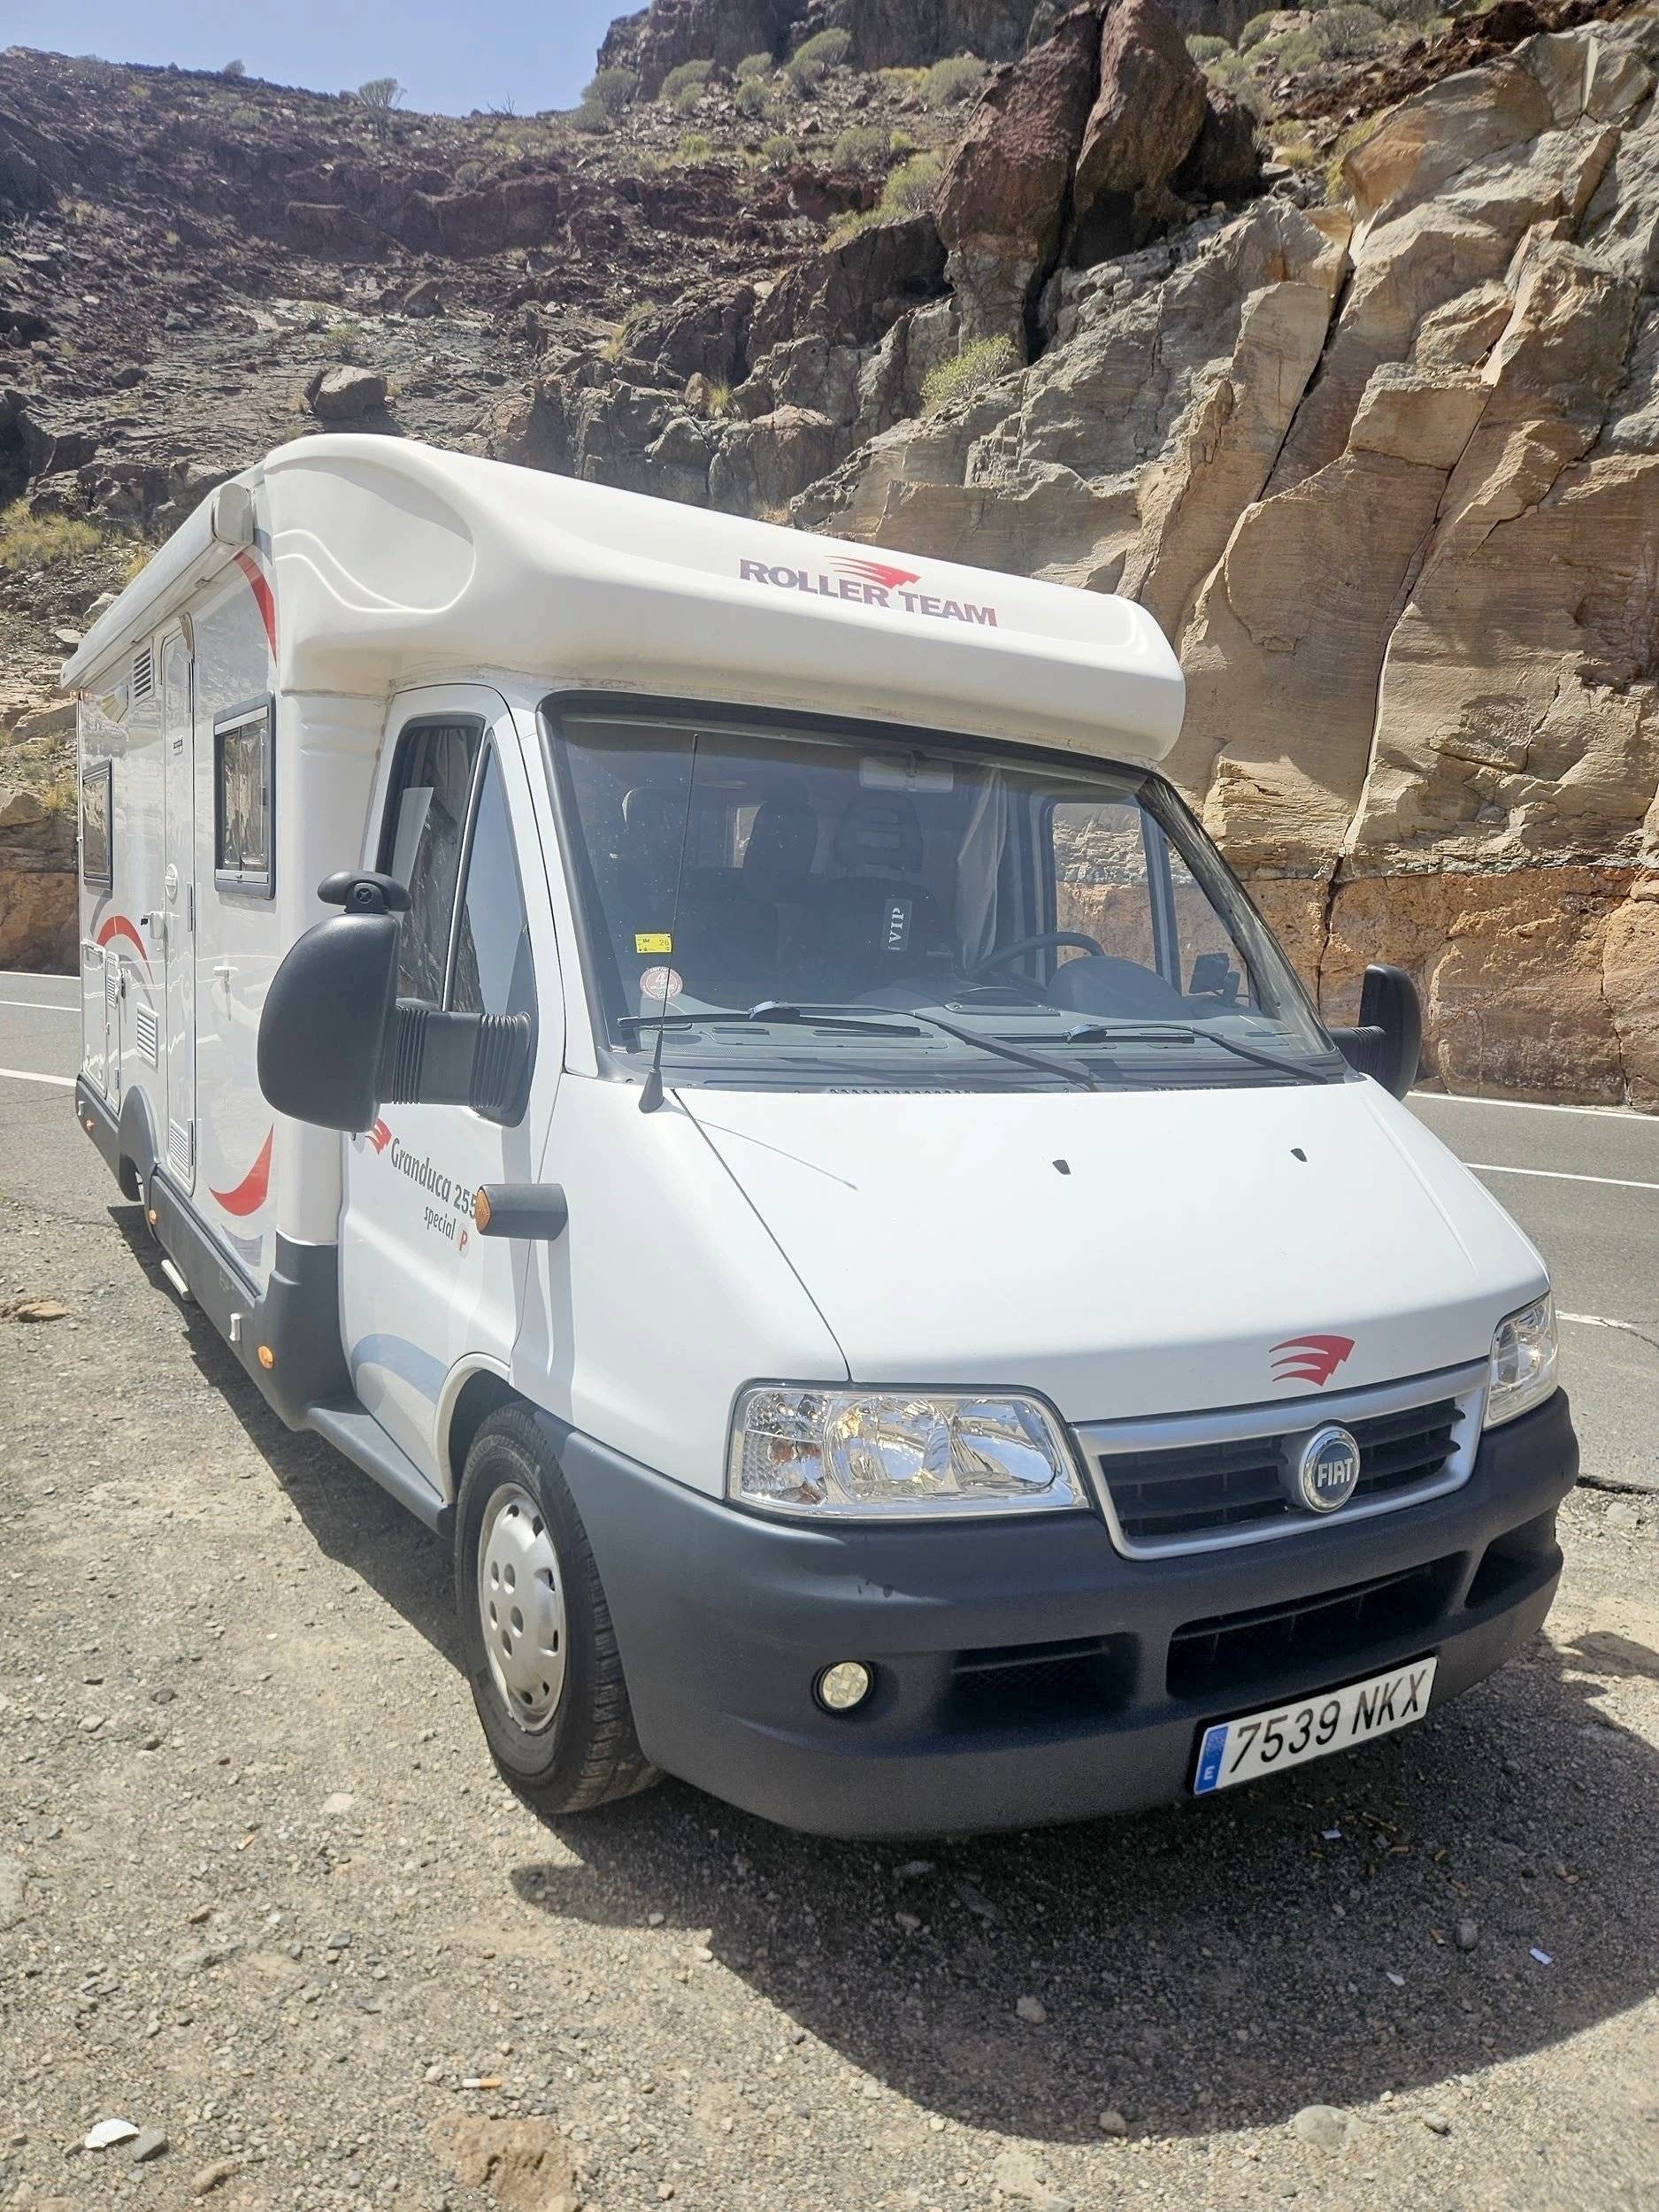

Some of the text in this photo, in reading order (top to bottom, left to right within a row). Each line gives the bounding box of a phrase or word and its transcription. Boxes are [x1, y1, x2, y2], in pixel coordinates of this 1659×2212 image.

[740, 558, 998, 627] ROLLER TEAM
[888, 907, 904, 943] VIP
[390, 1138, 478, 1219] Granduca 255
[423, 1206, 468, 1251] special P
[1317, 1457, 1354, 1488] FIAT
[1202, 1668, 1428, 1780] E 7539 NKX
